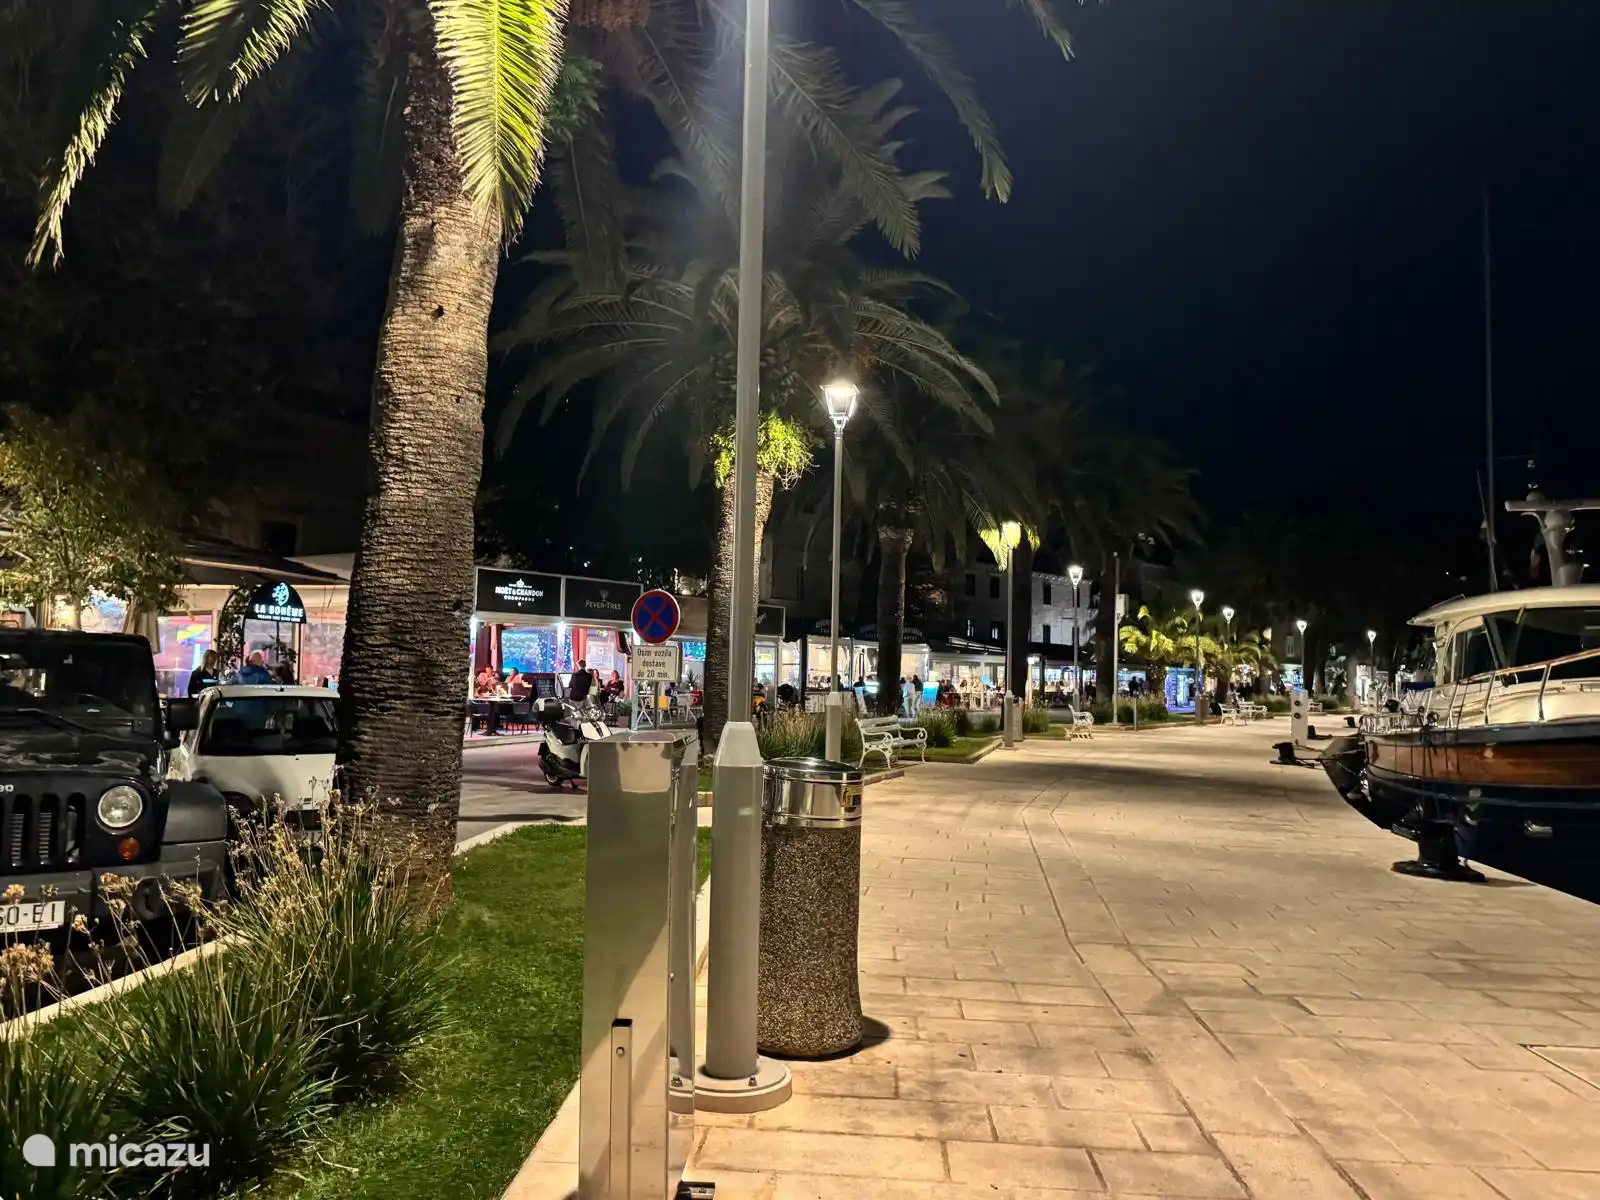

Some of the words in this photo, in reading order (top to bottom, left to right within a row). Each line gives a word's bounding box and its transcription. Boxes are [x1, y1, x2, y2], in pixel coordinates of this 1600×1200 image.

[254, 603, 266, 614] LA
[637, 648, 652, 657] Osim
[654, 649, 672, 657] vozila
[642, 660, 665, 668] dostave
[637, 669, 645, 677] do
[647, 669, 655, 678] 20
